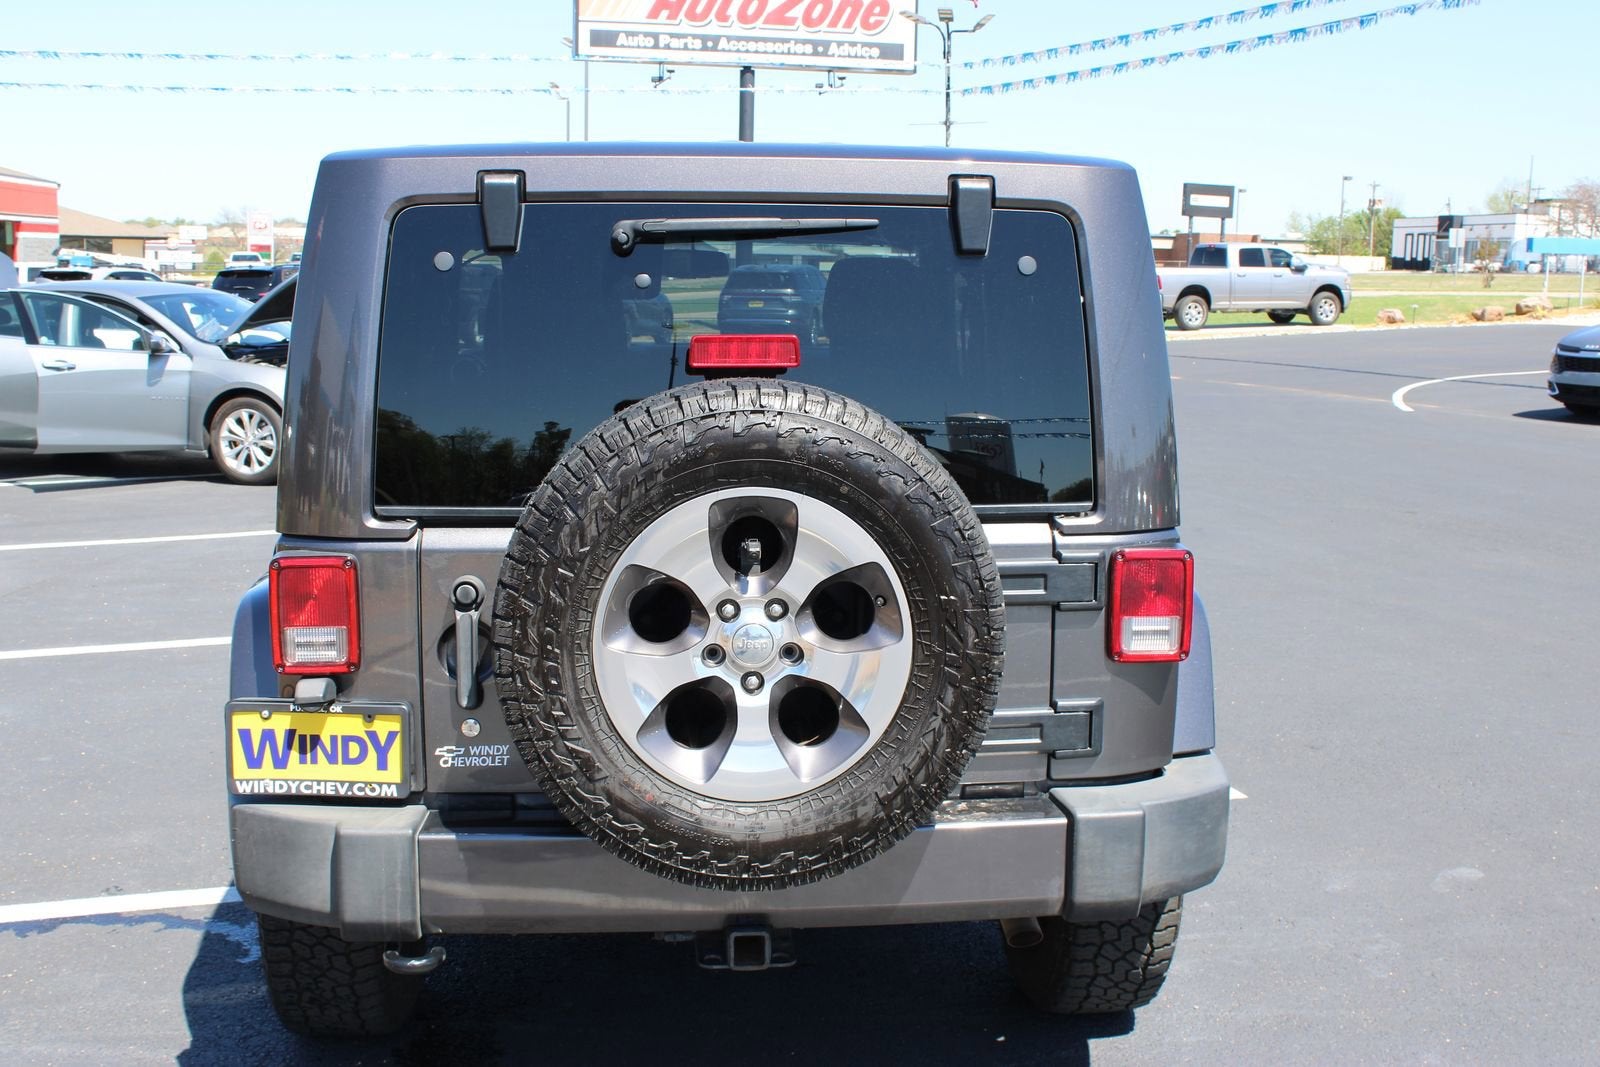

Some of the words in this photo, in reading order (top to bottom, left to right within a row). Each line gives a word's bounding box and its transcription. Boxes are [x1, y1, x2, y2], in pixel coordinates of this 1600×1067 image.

[616, 32, 655, 47] Auto
[659, 34, 702, 50] Parts
[717, 37, 813, 55] Accessories
[828, 42, 881, 59] Advice
[736, 638, 768, 651] Jeep
[329, 705, 343, 713] OK
[236, 729, 401, 771] WINDY
[469, 745, 509, 756] WINDY
[440, 756, 510, 767] CHEVROLET
[235, 780, 399, 797] WINDYCHEV.COM
